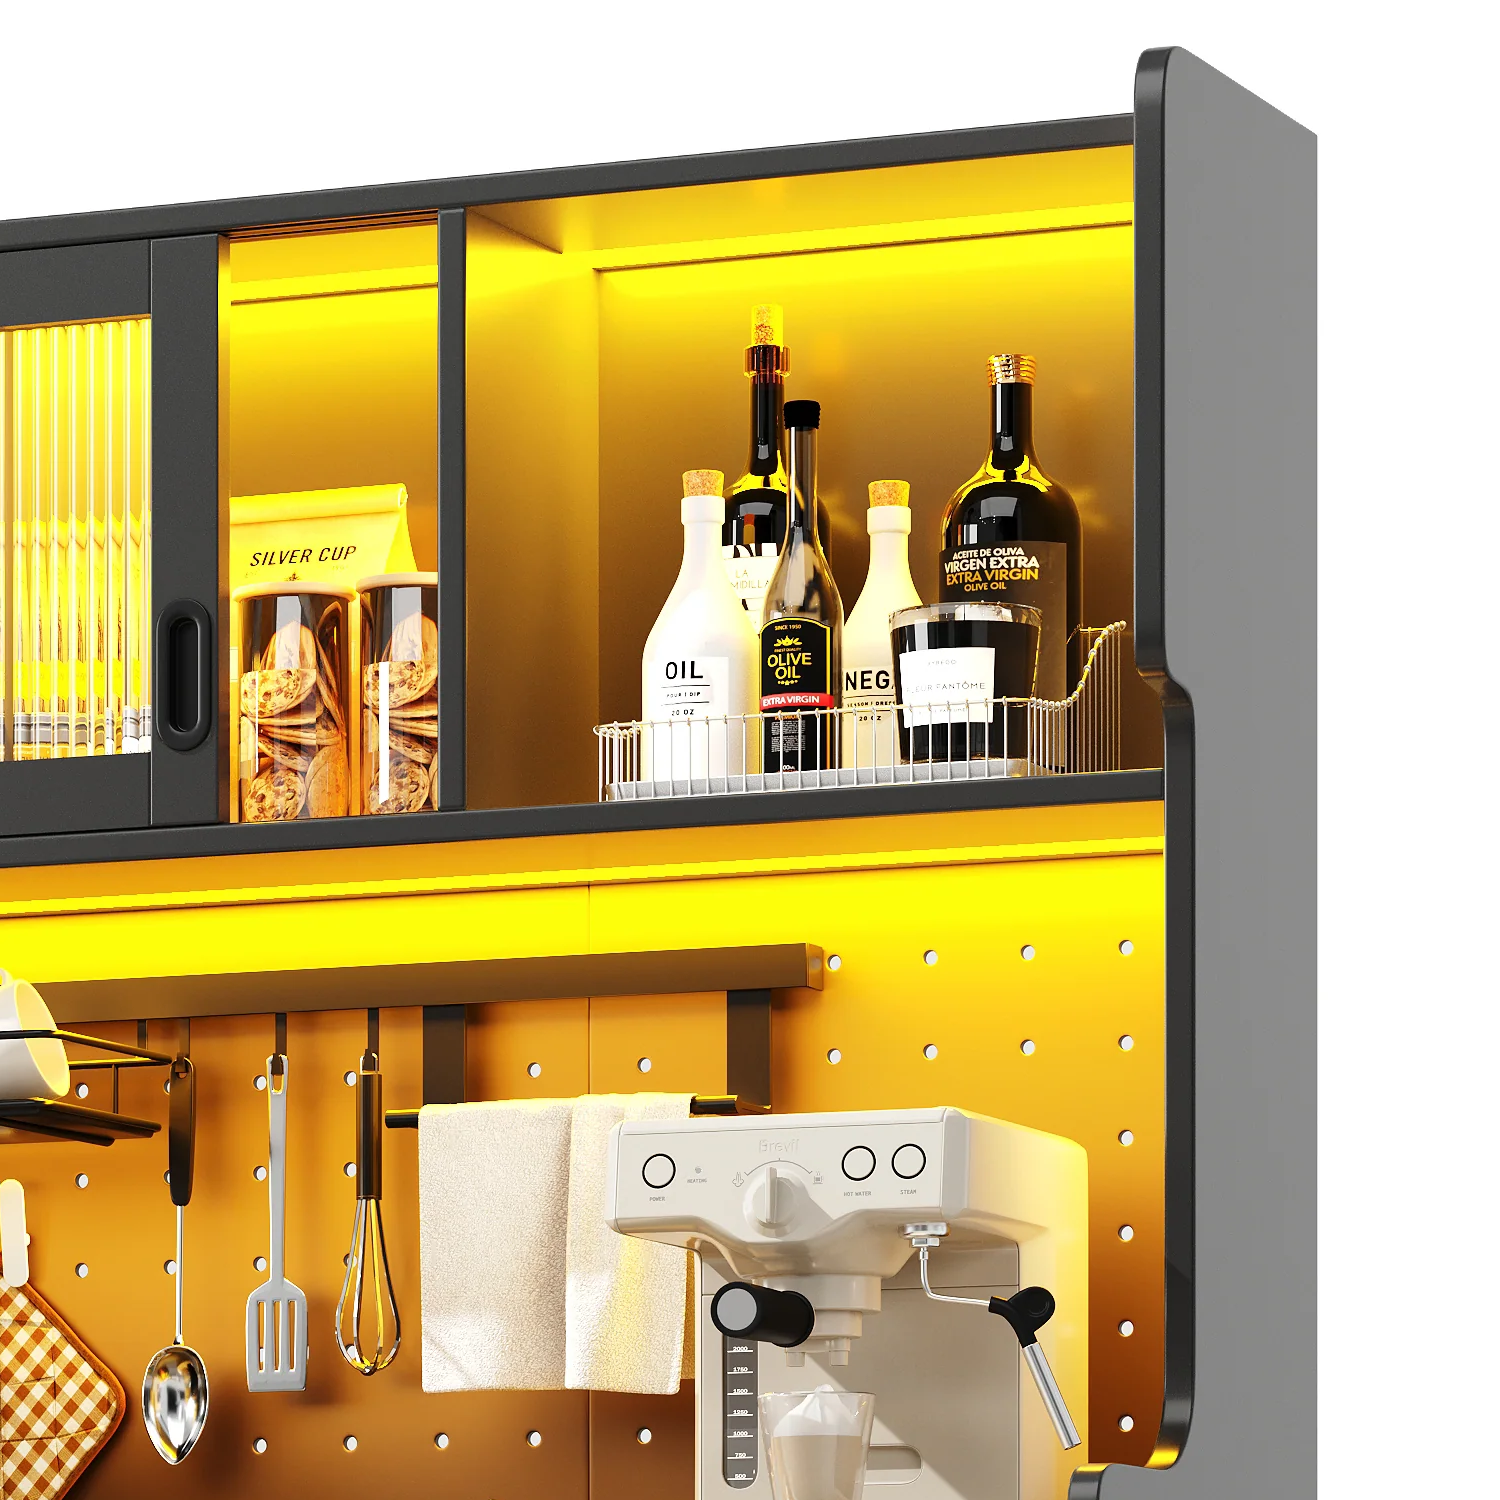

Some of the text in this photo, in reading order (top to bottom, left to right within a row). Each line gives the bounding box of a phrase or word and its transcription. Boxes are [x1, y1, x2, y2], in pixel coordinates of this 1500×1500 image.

[250, 545, 357, 567] SILVER CUP
[952, 546, 1025, 561] ACEITE DE OLIVA
[944, 555, 1040, 574] VIRGEN EXTRA
[946, 568, 1039, 586] EXTRA VIRGIN
[964, 581, 1007, 592] OLIVE OIL
[767, 652, 812, 668] OLIVE
[665, 660, 704, 680] OIL
[775, 665, 801, 680] OIL
[845, 669, 894, 691] NEG
[936, 680, 987, 690] FANTÔME
[762, 695, 820, 707] EXTRA VIRGIN
[683, 708, 695, 716] OZ
